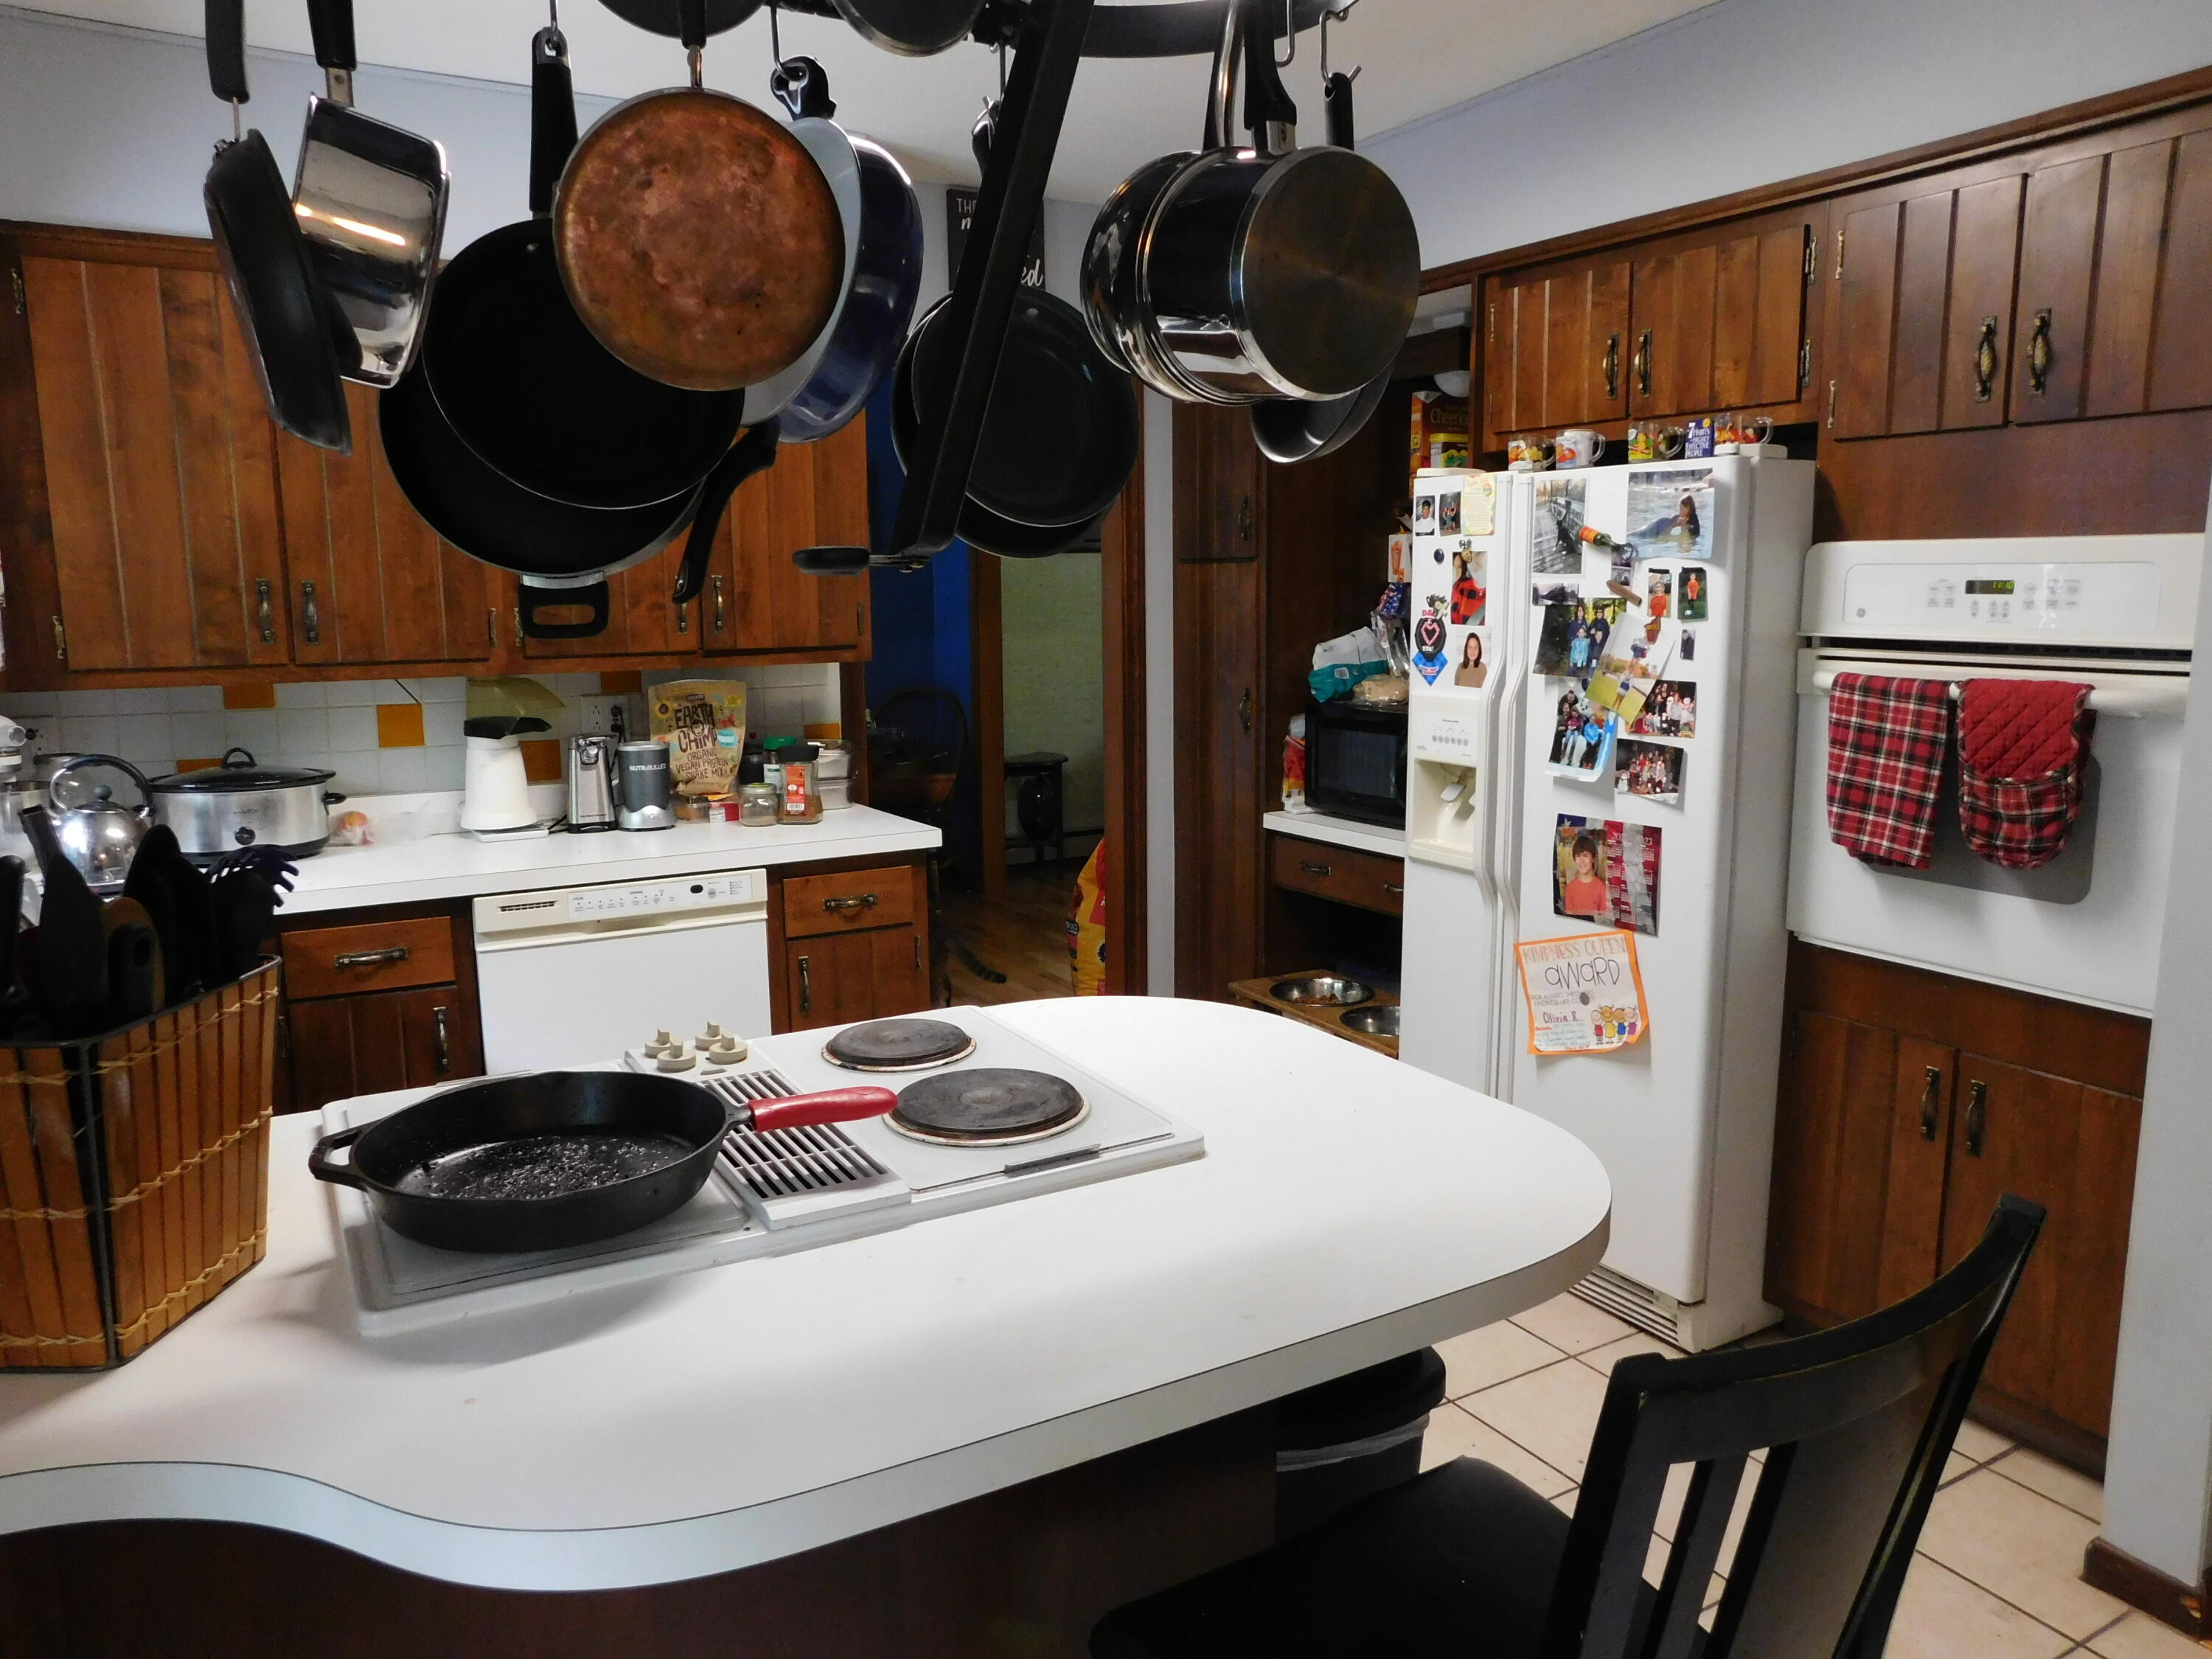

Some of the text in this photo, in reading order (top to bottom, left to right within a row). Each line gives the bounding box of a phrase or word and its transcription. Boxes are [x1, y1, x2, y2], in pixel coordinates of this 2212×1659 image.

[1688, 422, 1696, 439] 7
[675, 703, 715, 729] EARTH
[678, 725, 717, 753] CHIMP
[687, 748, 718, 762] ORGANIC
[675, 757, 728, 774] VEGAN PROTEIN
[686, 766, 724, 779] SHAKE MIX
[1523, 936, 1627, 964] KINDNESS QUEEN
[1543, 1012, 1569, 1023] Olivia
